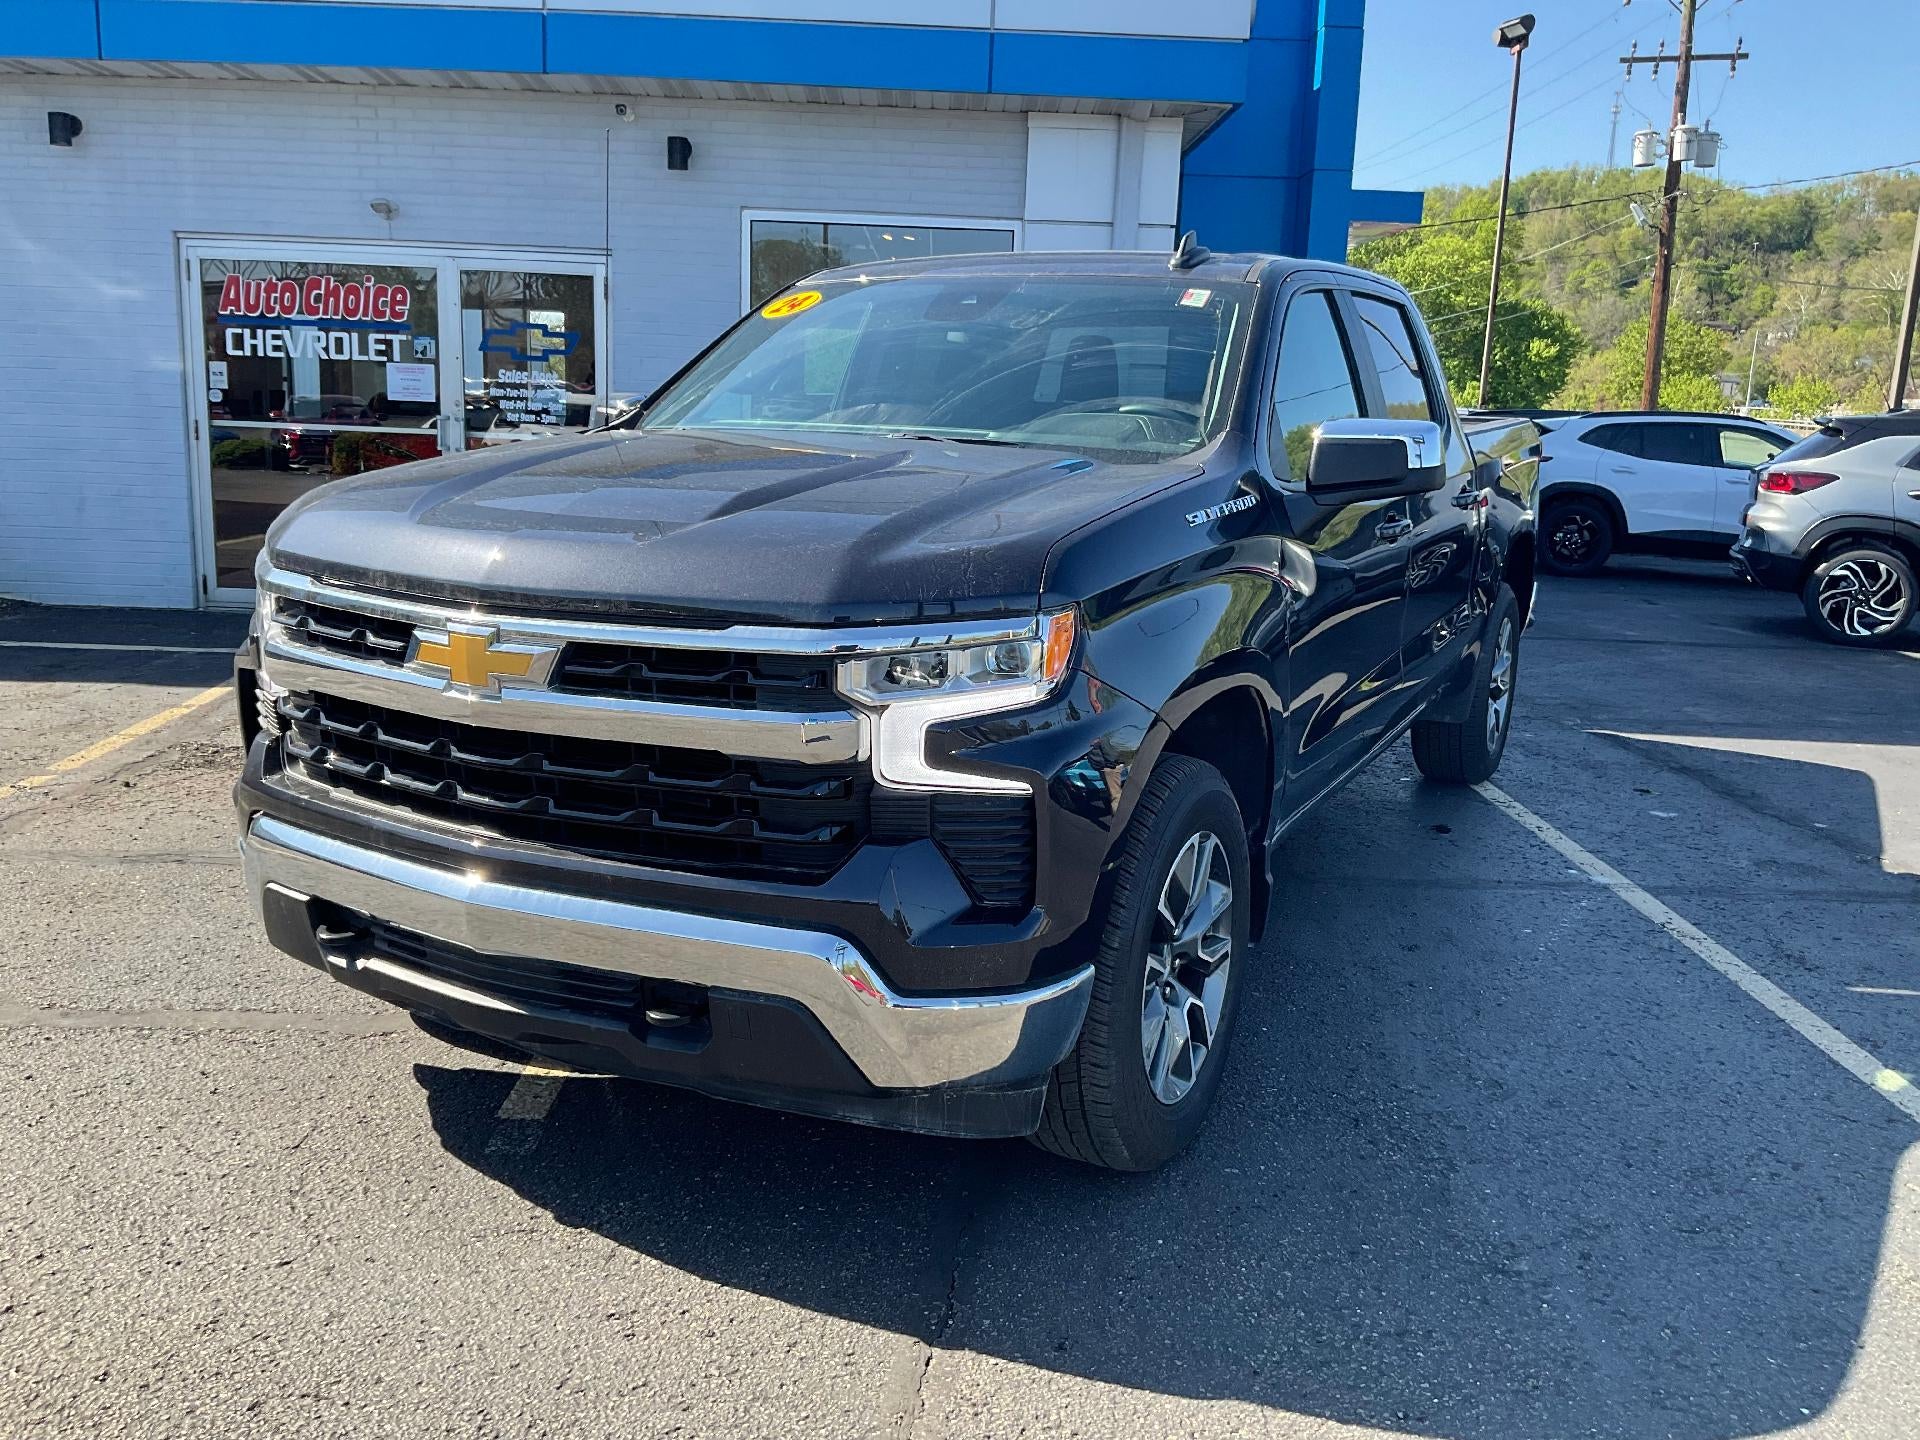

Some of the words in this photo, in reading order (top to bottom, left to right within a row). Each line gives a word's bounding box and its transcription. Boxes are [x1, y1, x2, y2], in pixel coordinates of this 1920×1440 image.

[218, 273, 300, 318] Auto
[302, 274, 411, 322] Choice
[225, 328, 407, 362] CHEVROLET
[498, 368, 528, 384] Sales
[500, 400, 526, 410] Wed-Fri
[506, 412, 519, 422] Sat
